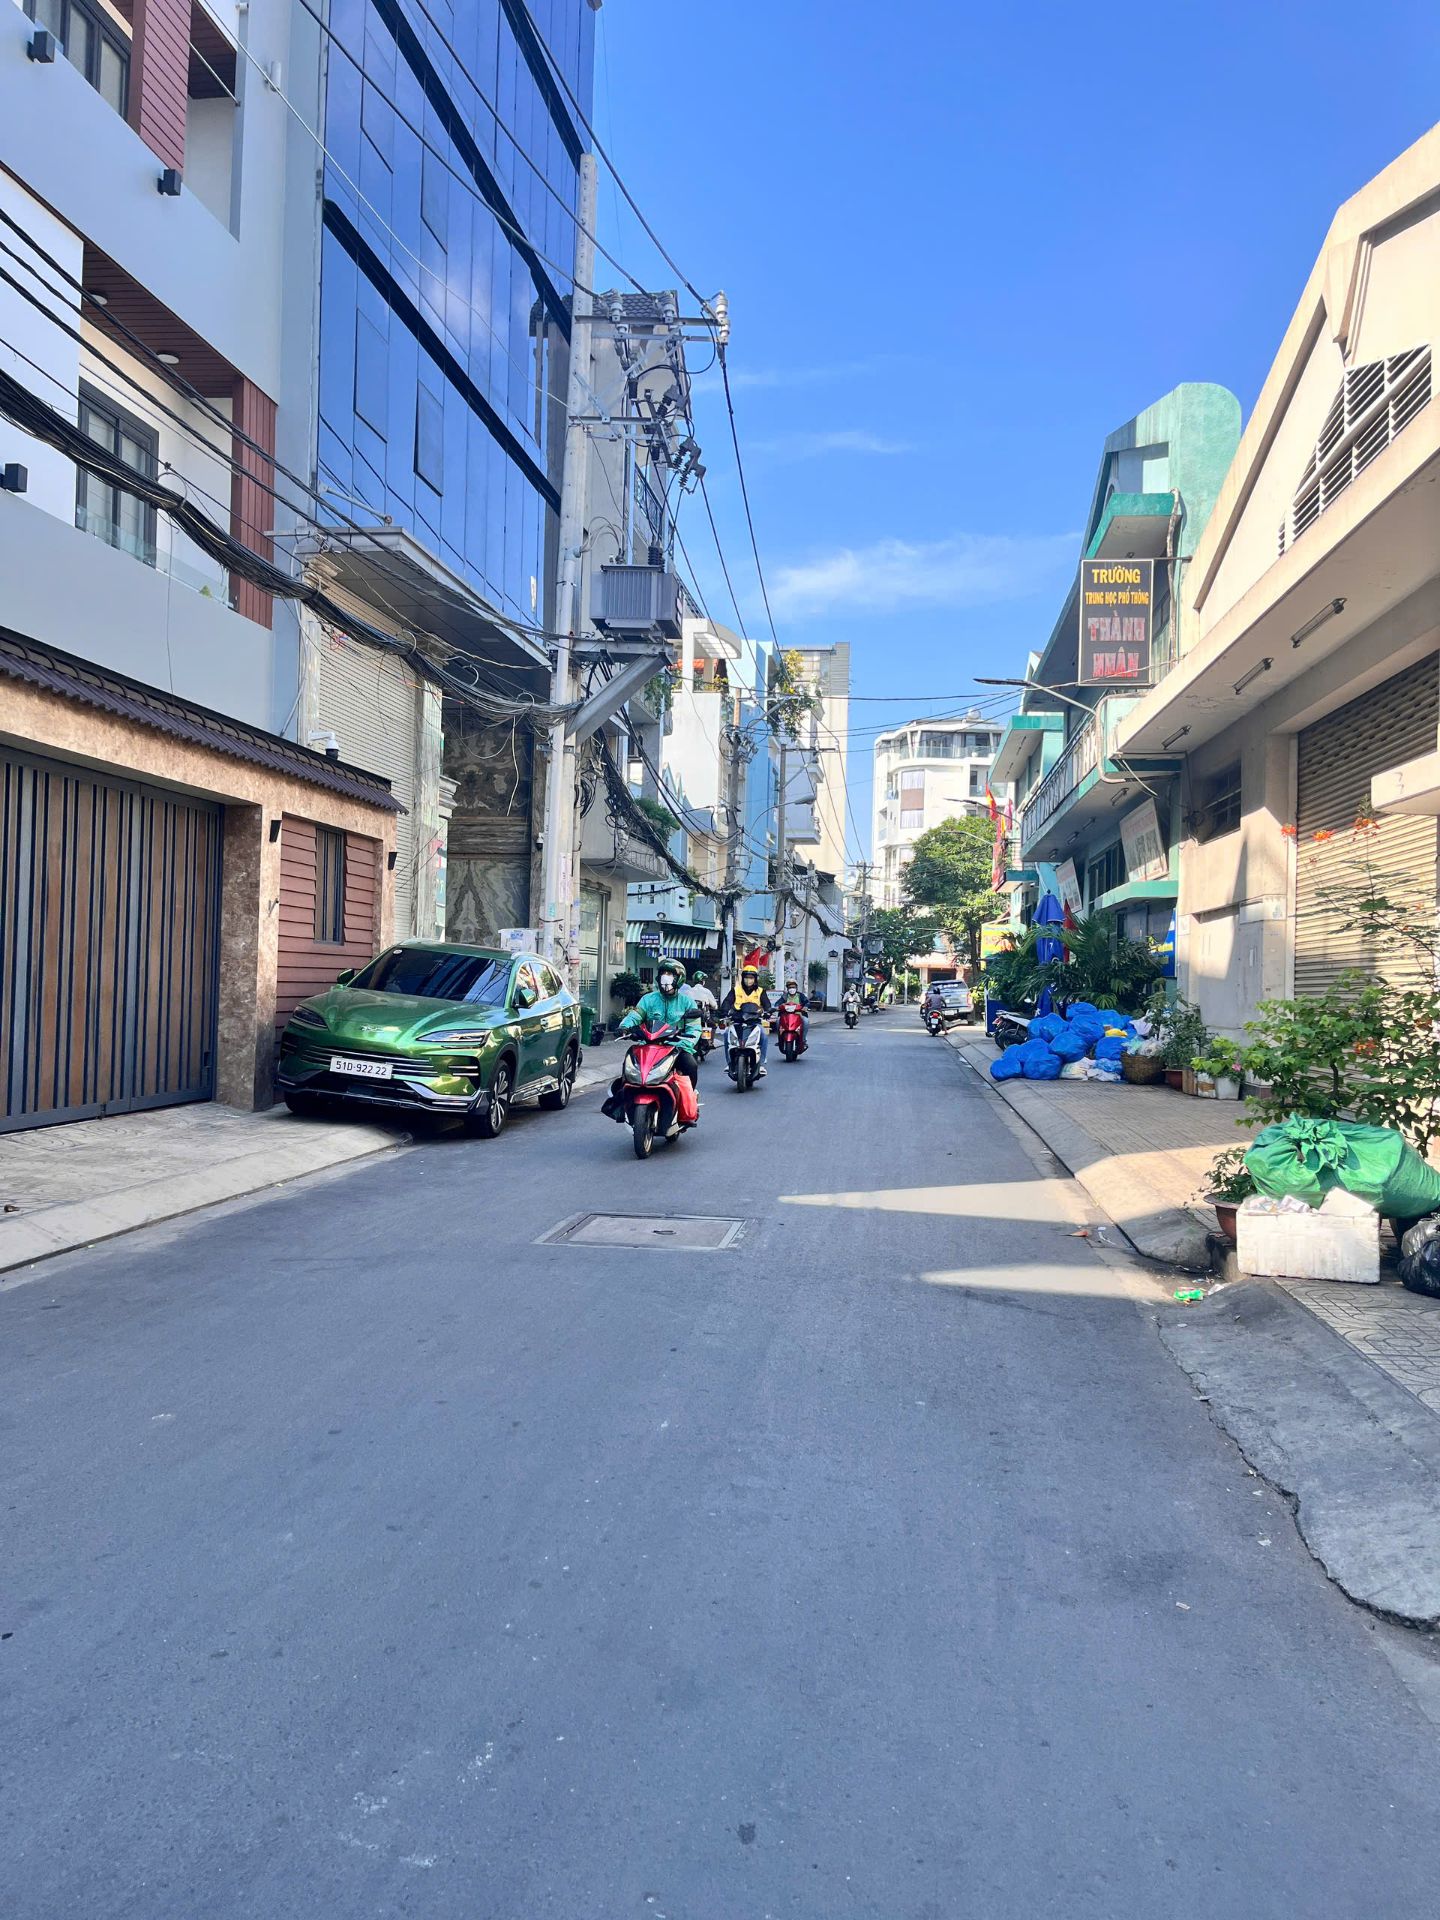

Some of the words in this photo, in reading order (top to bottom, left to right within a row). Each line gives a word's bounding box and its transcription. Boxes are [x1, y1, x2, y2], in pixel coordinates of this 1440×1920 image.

[1092, 565, 1141, 584] TRƯỜNG
[1085, 591, 1104, 605] TRUNG
[1105, 591, 1117, 607] HỌC
[1088, 610, 1145, 641] THÀNH
[1093, 646, 1140, 678] NHÂN
